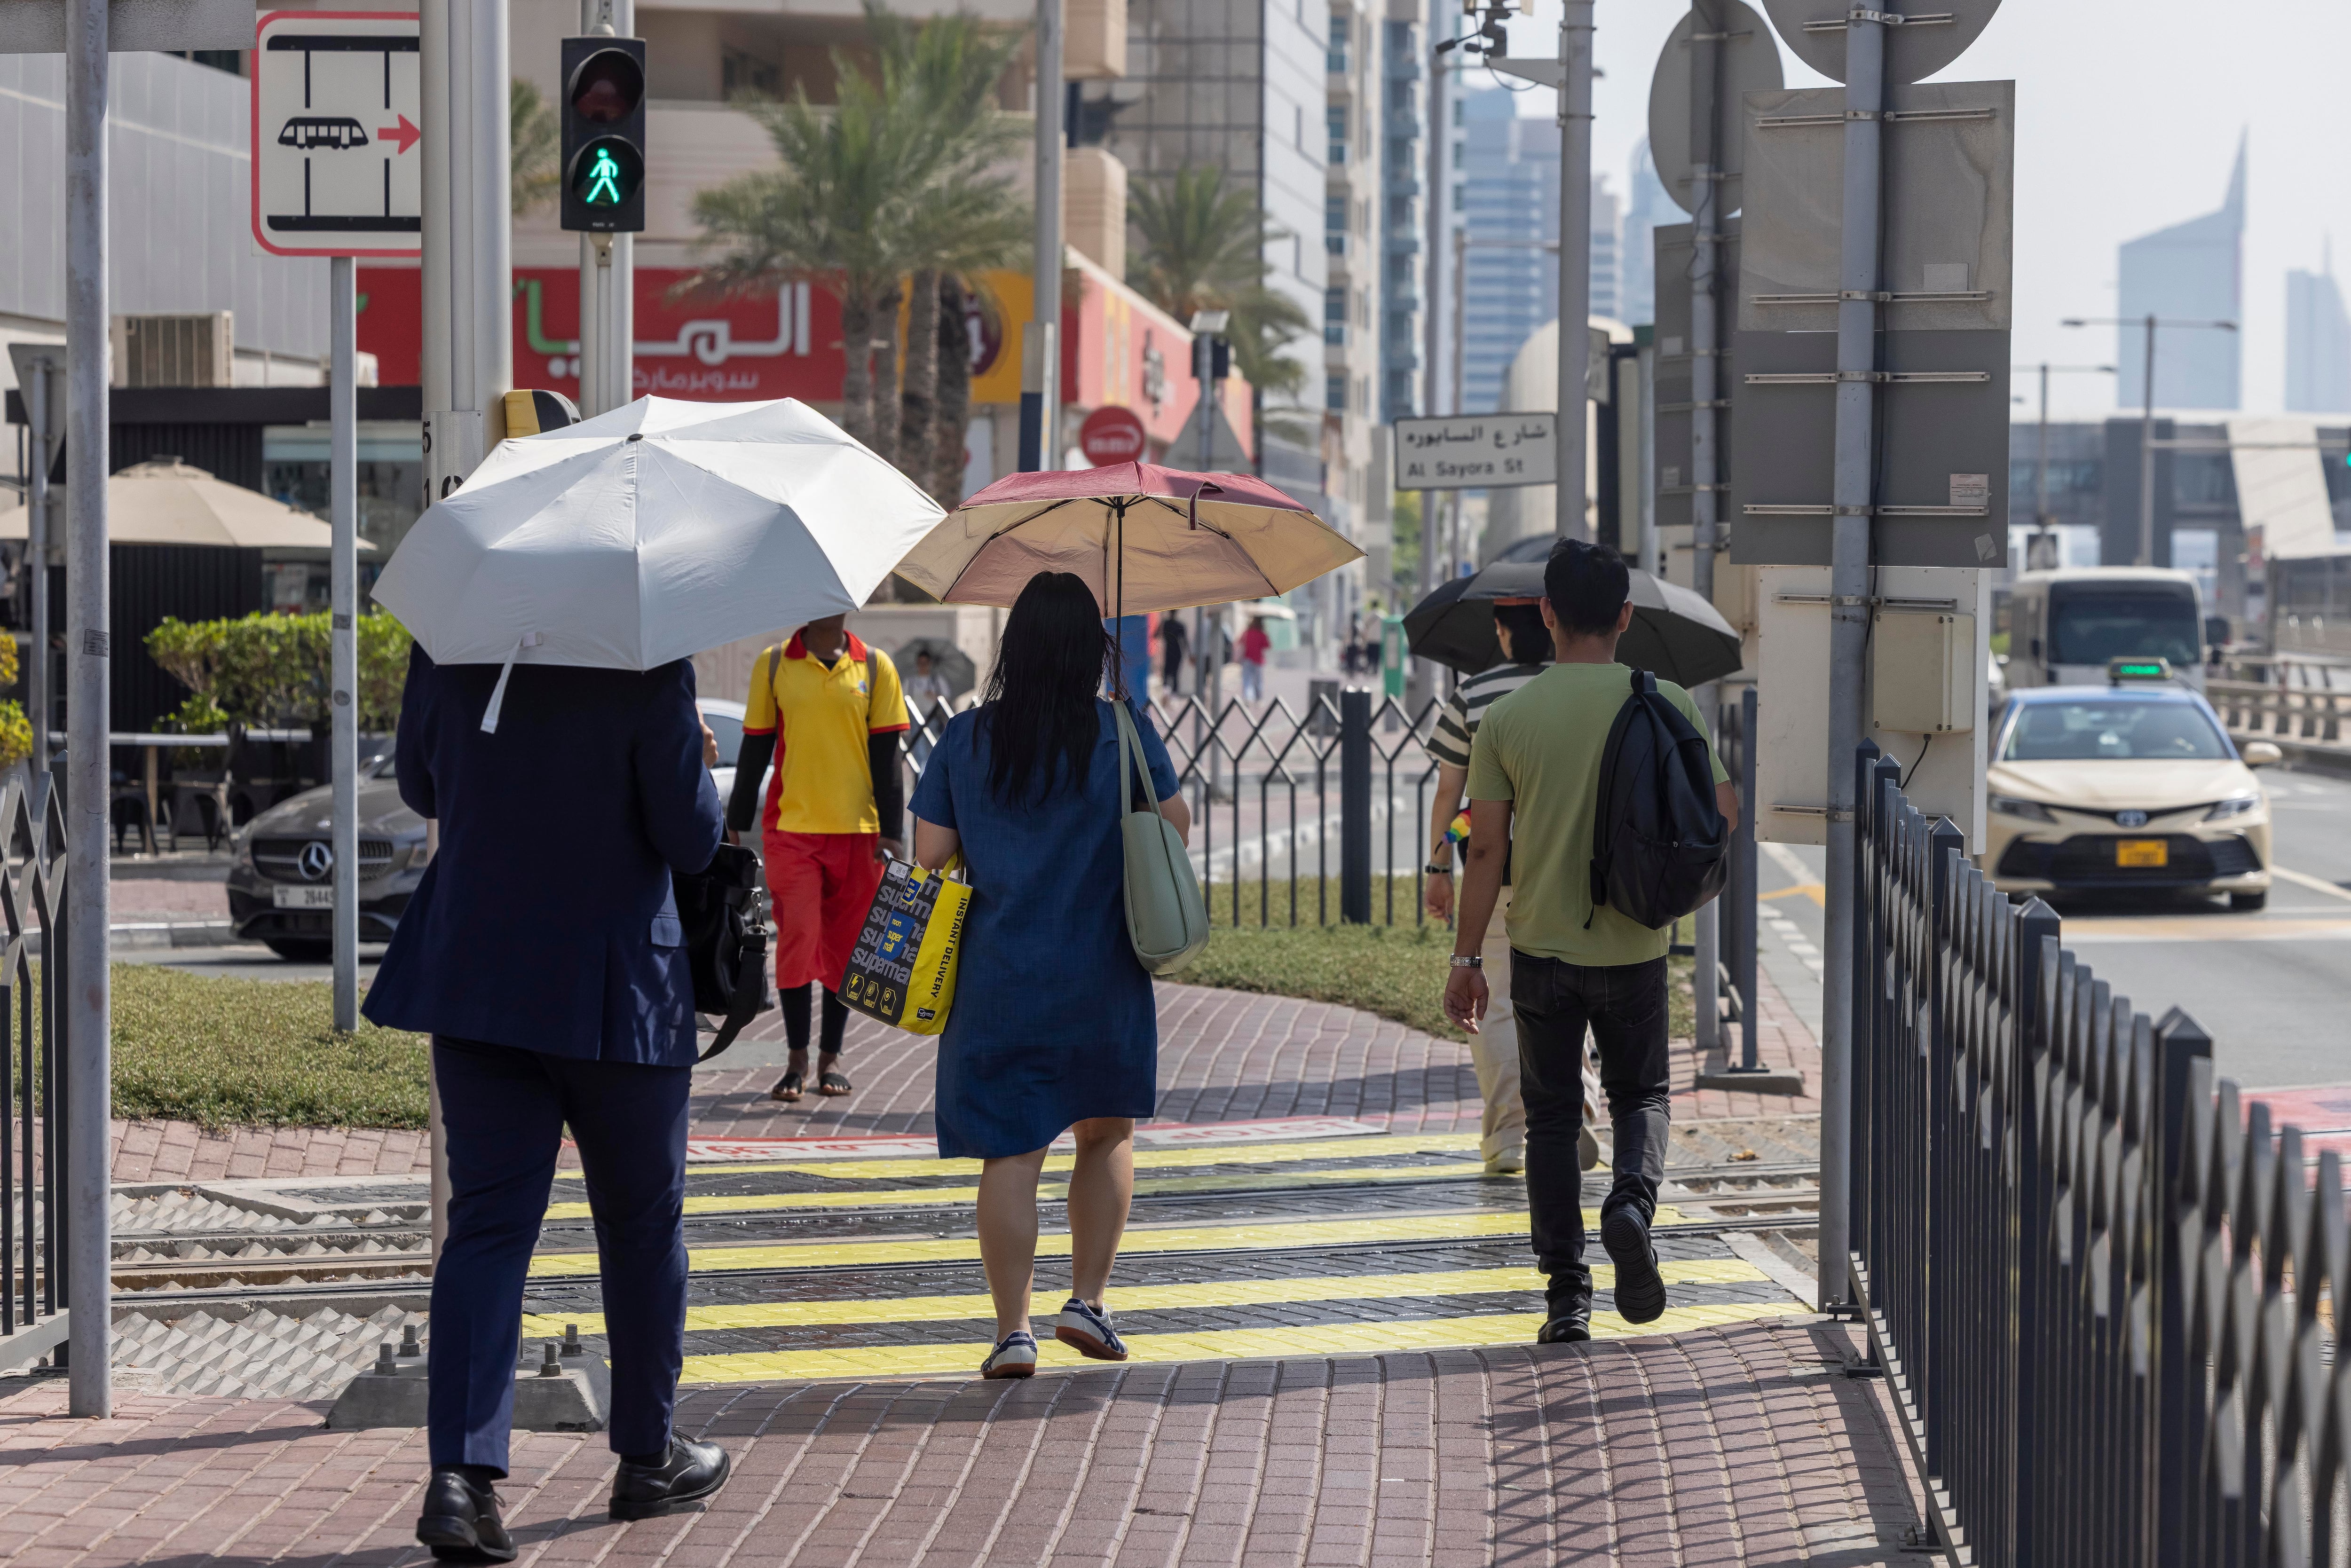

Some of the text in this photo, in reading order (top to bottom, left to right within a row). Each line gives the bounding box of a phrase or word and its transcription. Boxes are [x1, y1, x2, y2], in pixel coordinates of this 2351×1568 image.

[1494, 424, 1547, 448] شارع
[1407, 458, 1523, 478] Al Sayora St
[891, 919, 902, 927] noon
[887, 930, 903, 942] super
[883, 942, 894, 953] mall
[931, 898, 968, 998] INSTANT DELIVERY
[851, 947, 911, 985] superma
